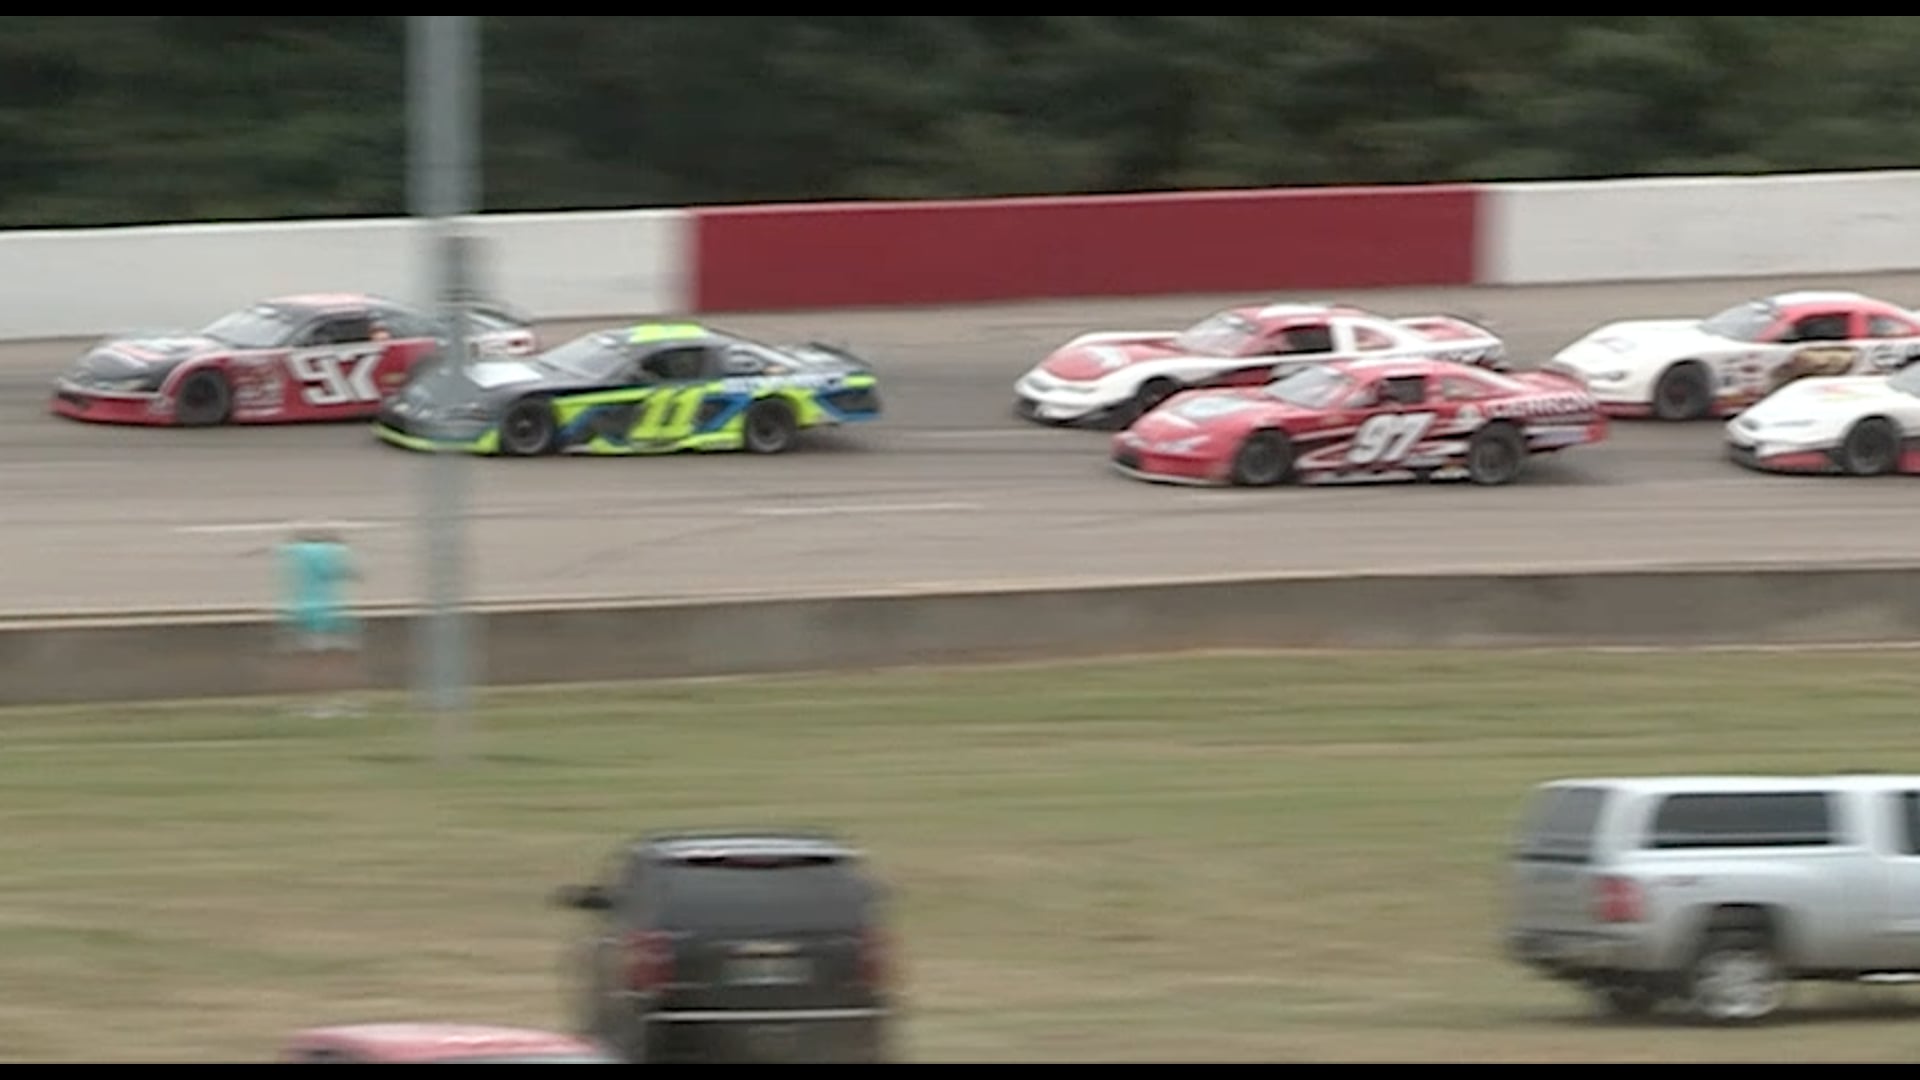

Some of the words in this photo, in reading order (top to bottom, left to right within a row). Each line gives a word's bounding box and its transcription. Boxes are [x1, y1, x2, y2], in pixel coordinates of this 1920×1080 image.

[289, 344, 384, 404] 97
[631, 387, 703, 439] 11
[1346, 412, 1436, 463] 97
